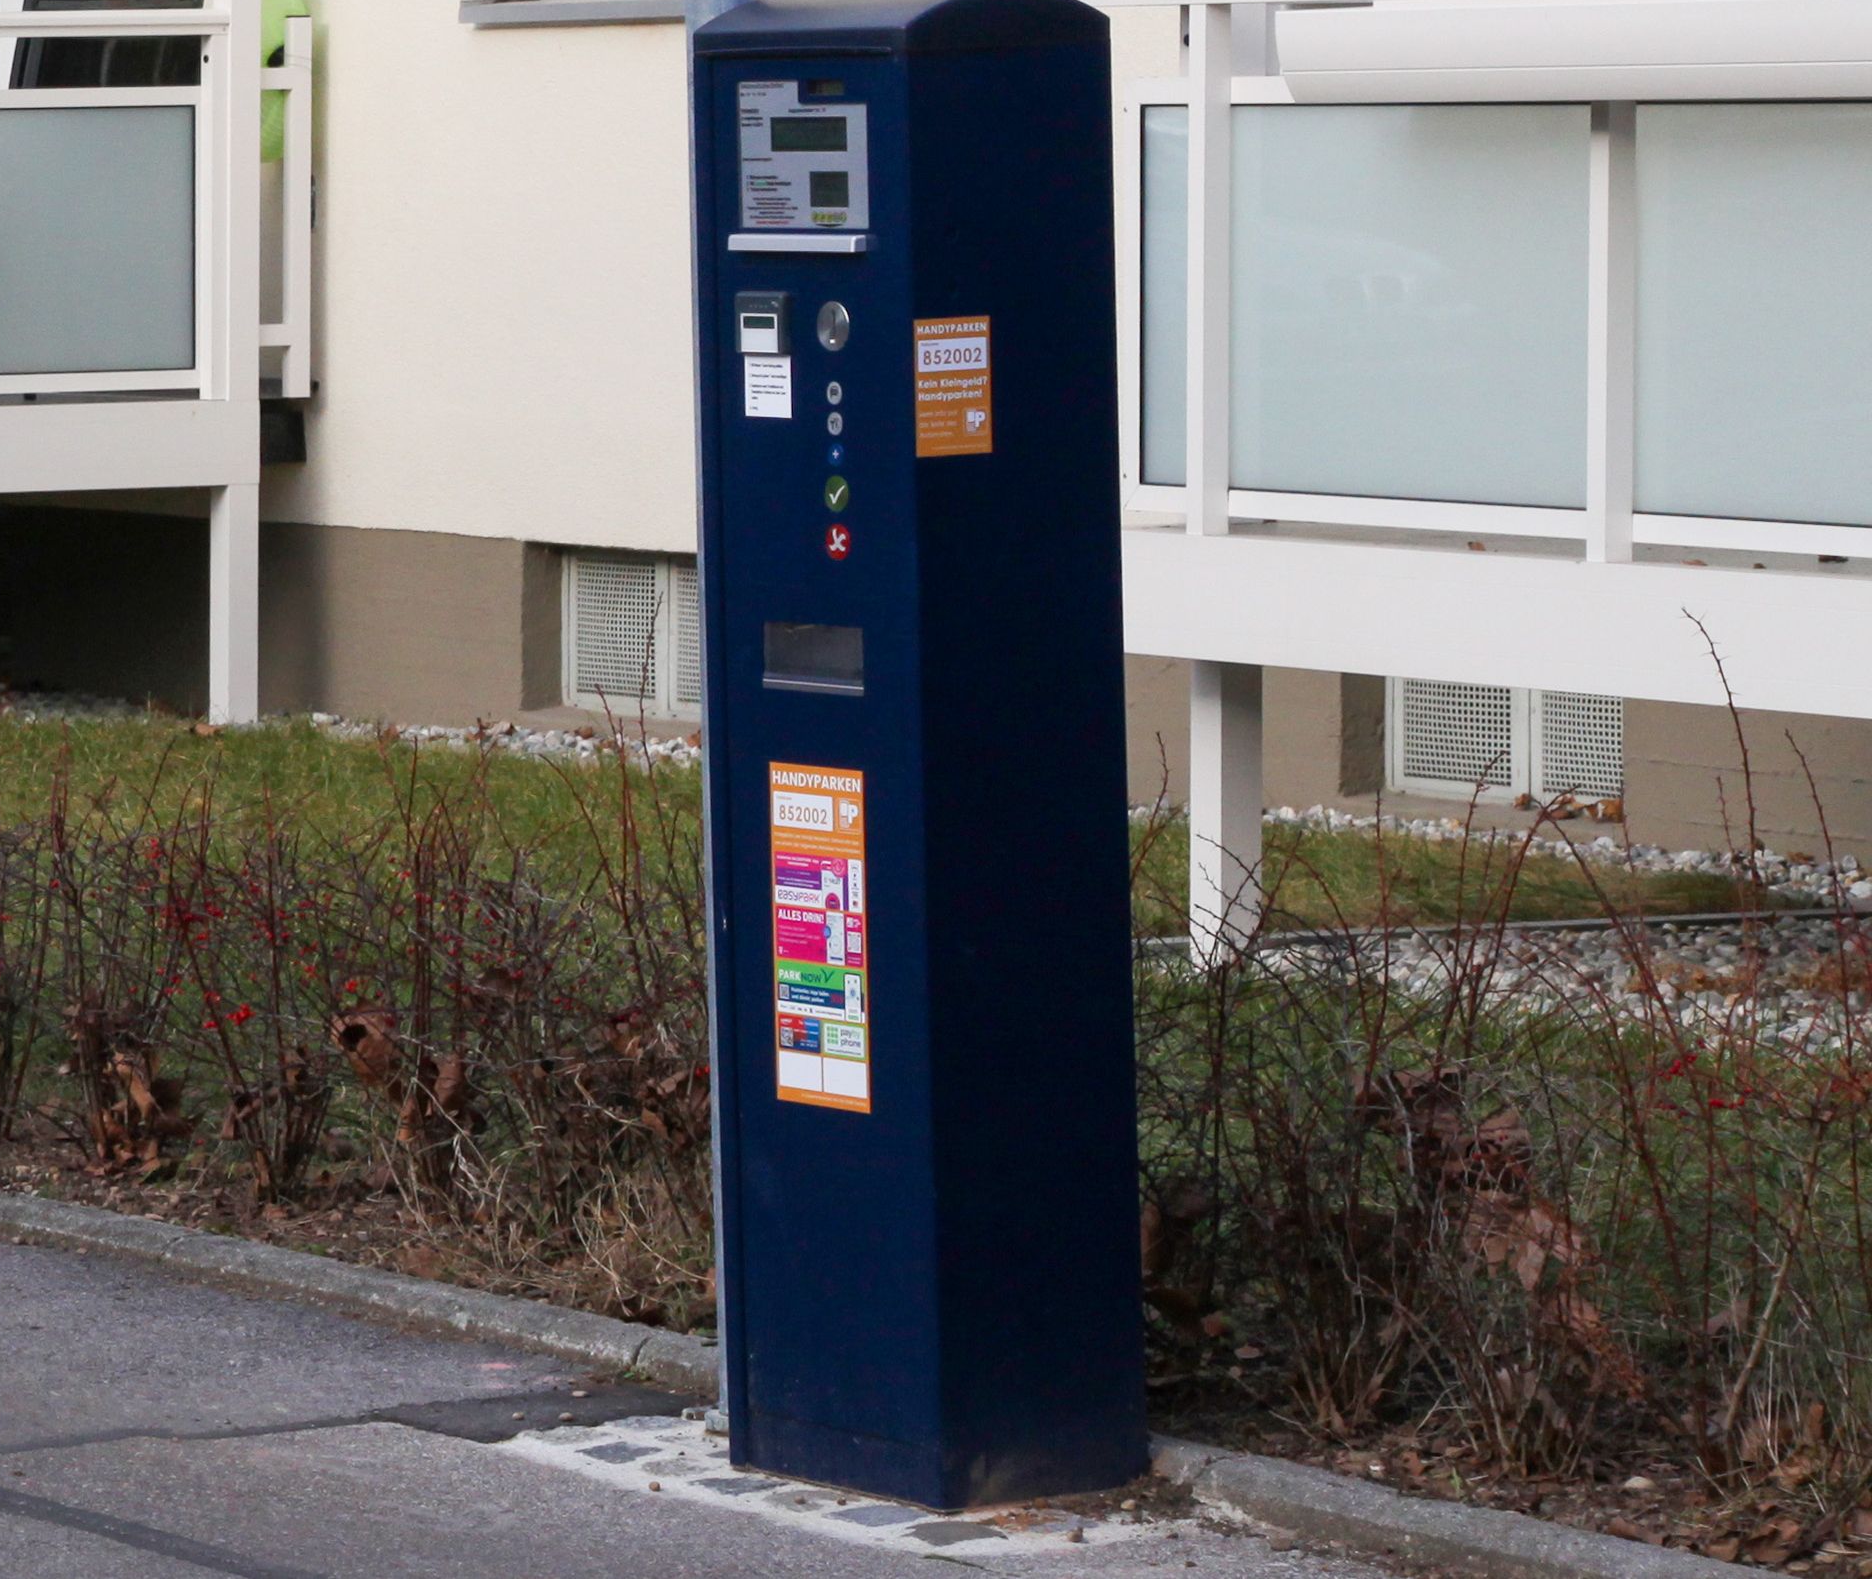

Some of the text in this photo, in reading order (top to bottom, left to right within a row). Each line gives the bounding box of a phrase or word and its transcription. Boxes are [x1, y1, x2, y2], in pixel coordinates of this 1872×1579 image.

[916, 321, 988, 335] HANDYPARKEN
[923, 347, 983, 366] 852002
[918, 375, 988, 389] Kein Kleingeld?
[918, 389, 983, 402] Handyparken!
[772, 770, 861, 793] HANDYPARKEN
[778, 804, 828, 825] 852002
[777, 908, 802, 922] ALLES
